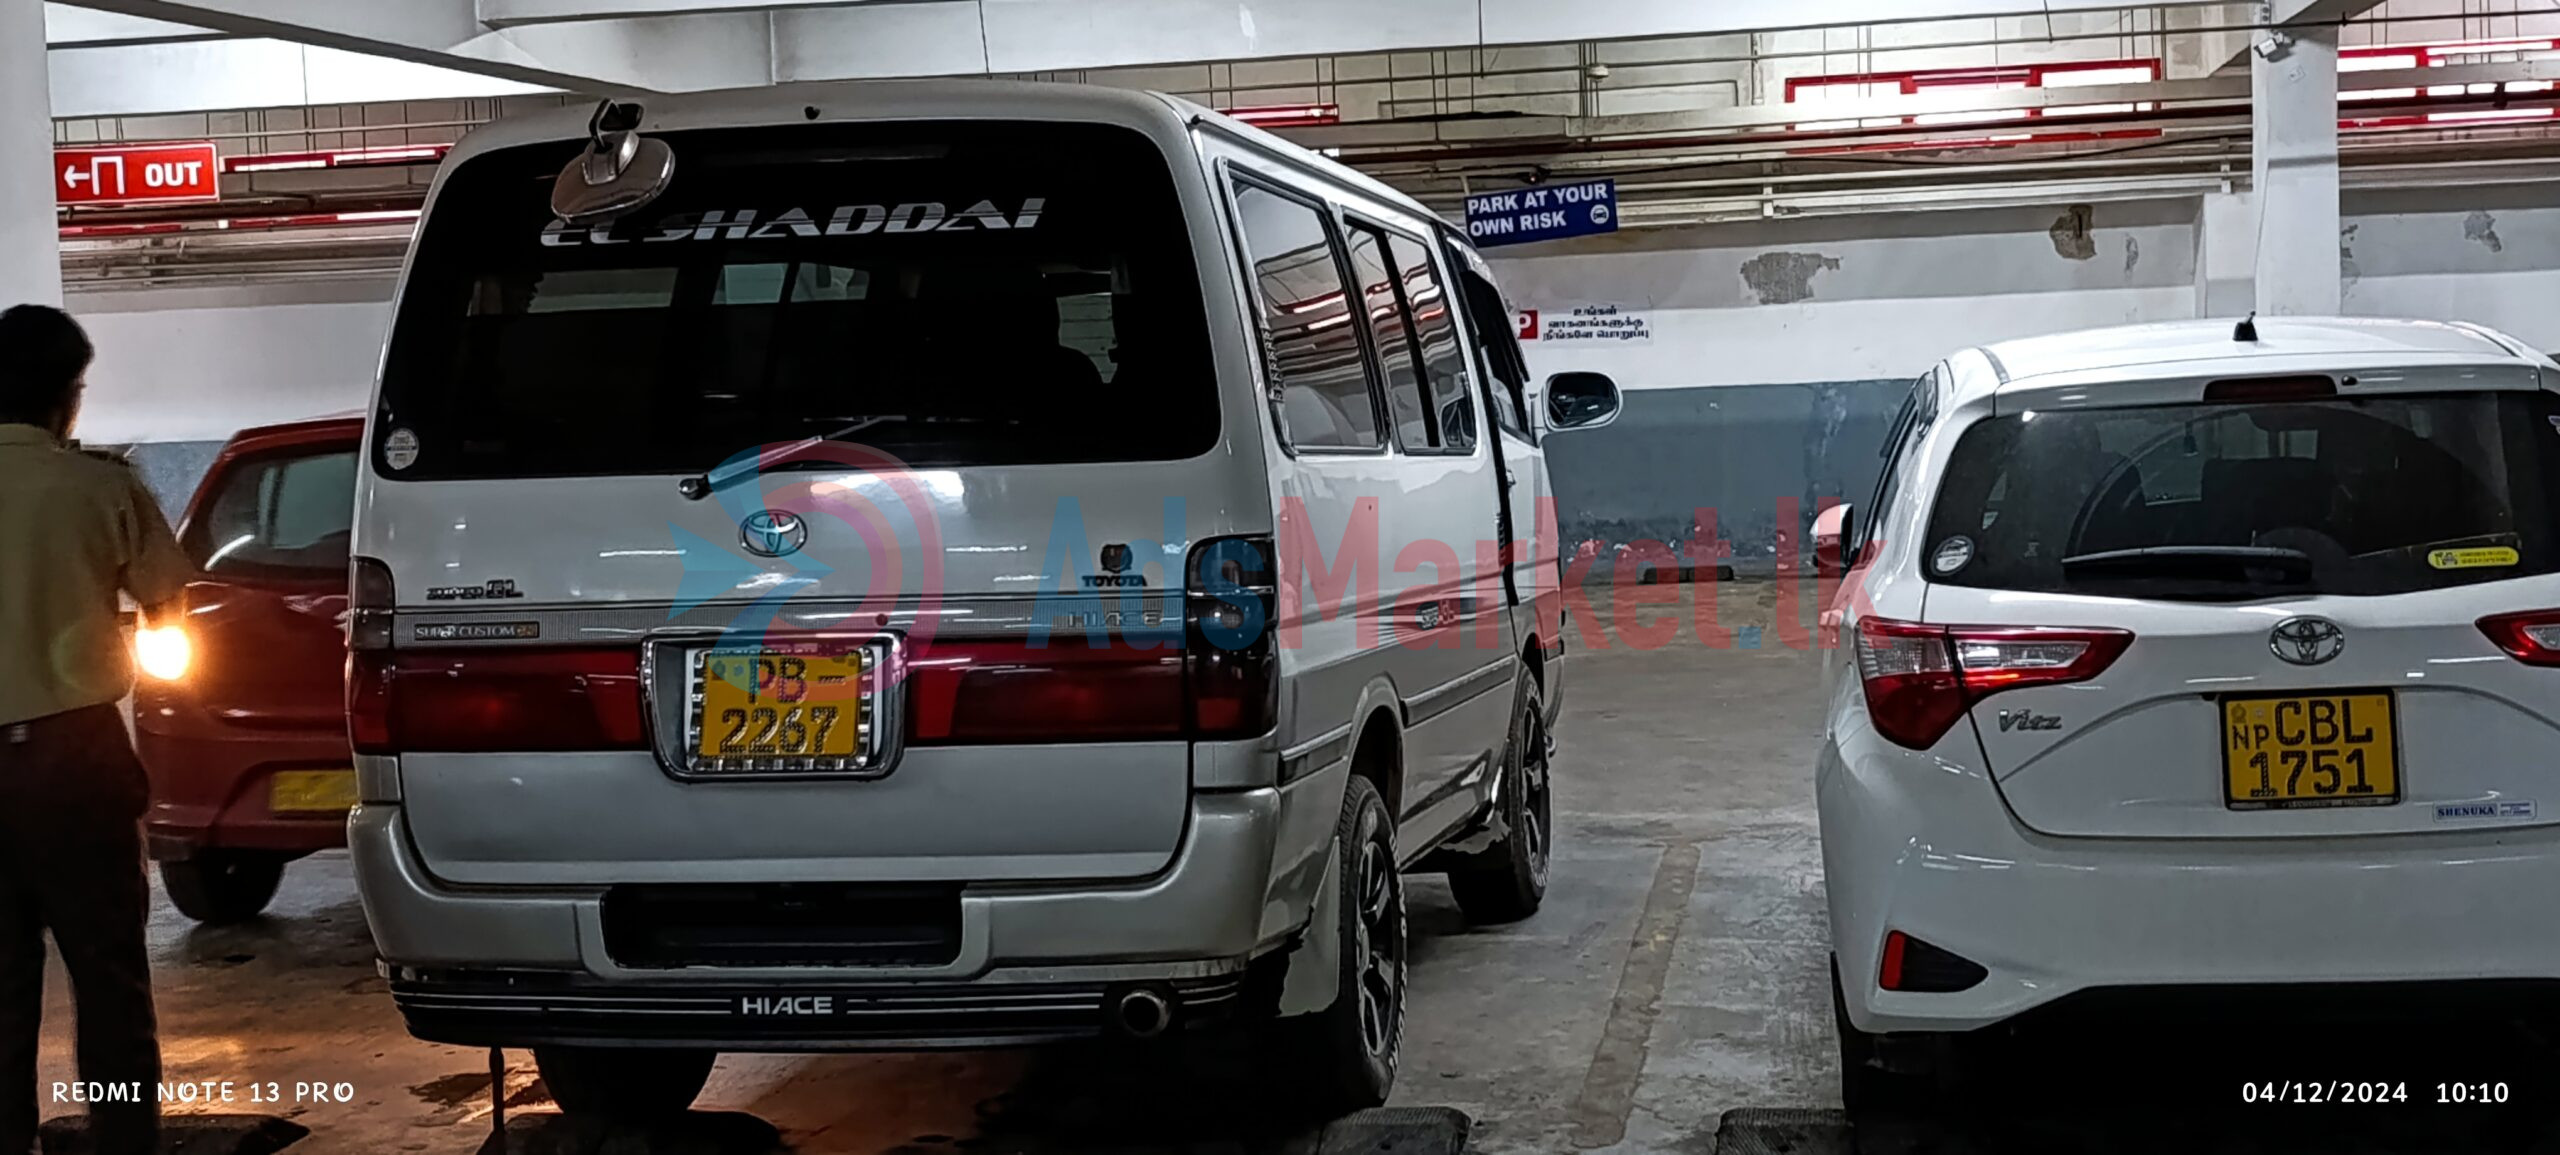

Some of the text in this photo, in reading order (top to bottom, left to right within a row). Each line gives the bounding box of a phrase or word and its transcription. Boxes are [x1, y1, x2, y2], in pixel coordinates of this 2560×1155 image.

[144, 160, 203, 187] OUT
[1467, 183, 1608, 215] PARK AT YOUR
[643, 197, 1046, 243] SHADDAI
[1470, 210, 1567, 237] OWN RISK
[1081, 574, 1148, 587] TOYOTA
[459, 624, 515, 637] CUSTOM
[1068, 609, 1163, 627] HIACE
[719, 706, 840, 754] 2267
[2232, 699, 2373, 750] NP CBL
[2249, 748, 2374, 797] 1751
[2437, 806, 2495, 817] SHENUKA
[742, 996, 833, 1015] HIACE
